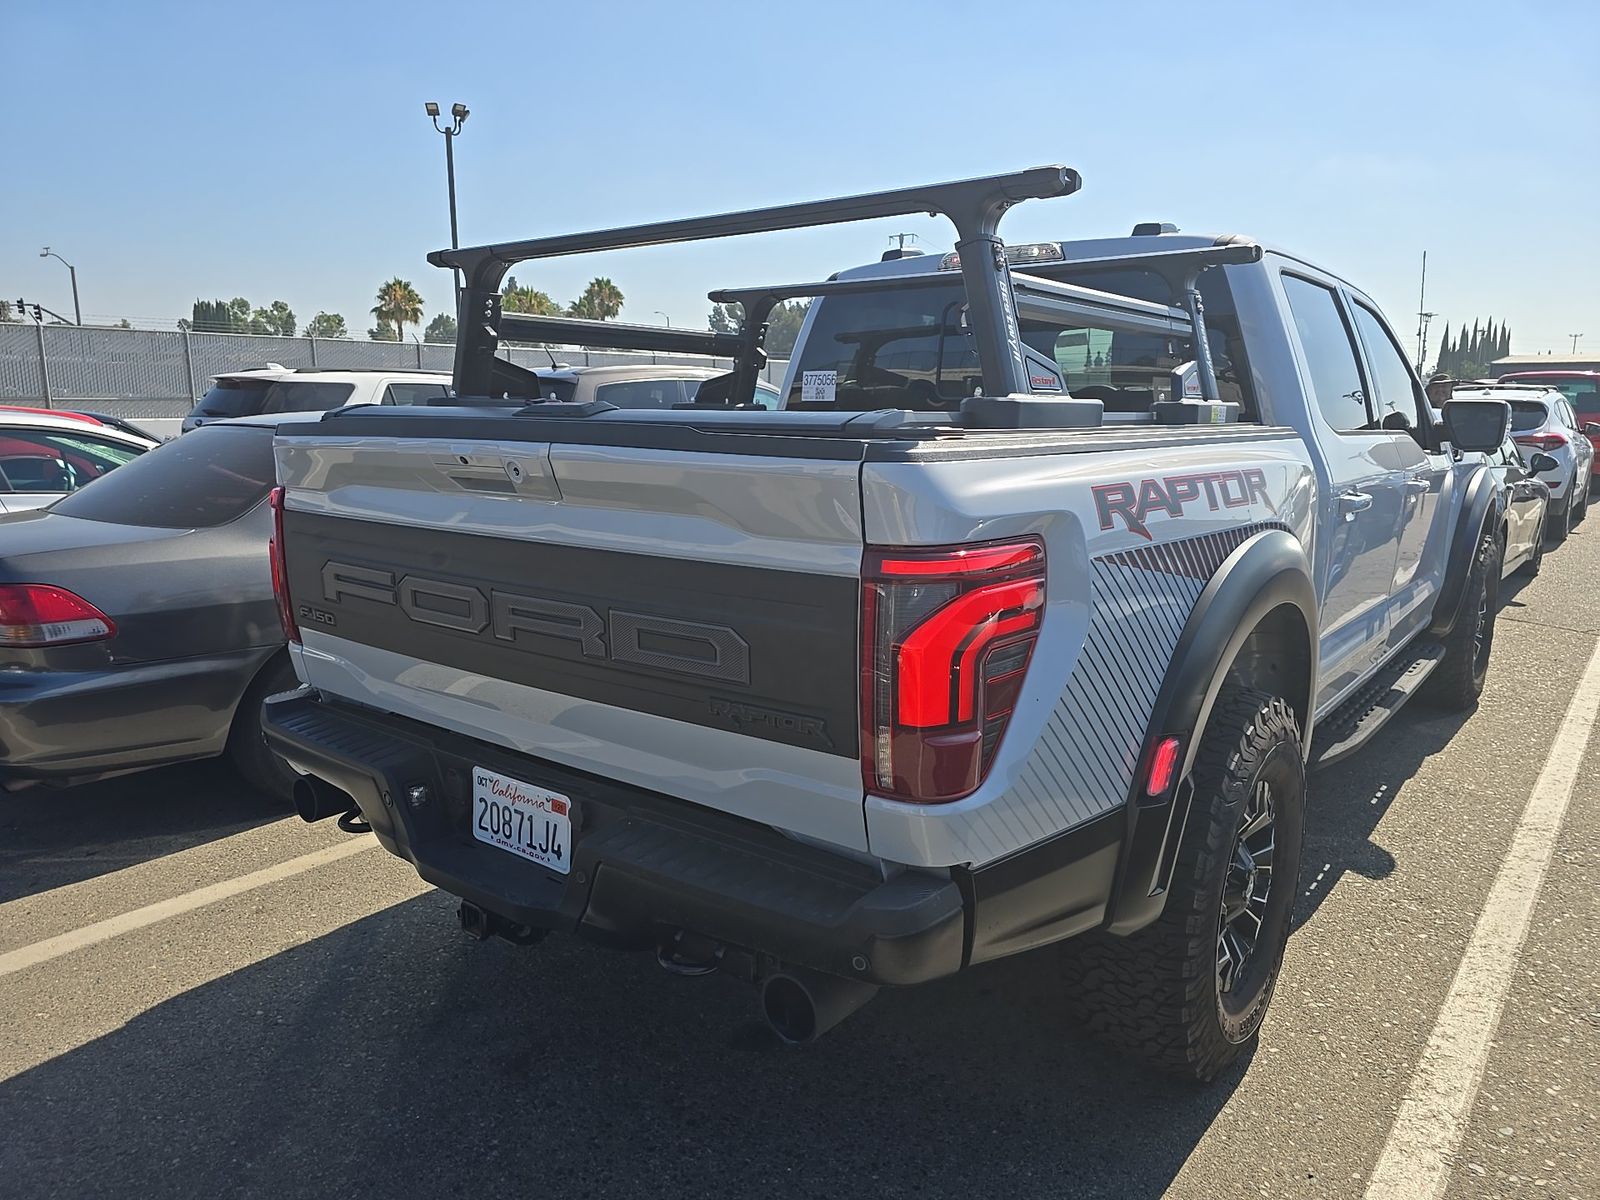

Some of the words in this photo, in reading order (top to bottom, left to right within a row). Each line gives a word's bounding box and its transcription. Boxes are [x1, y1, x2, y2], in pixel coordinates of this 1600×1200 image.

[1091, 468, 1278, 541] RAPTOR
[320, 559, 751, 686] FORD
[708, 696, 836, 748] RAPTOR
[477, 775, 488, 787] OCT
[491, 779, 552, 813] California
[479, 797, 562, 861] 20871J4
